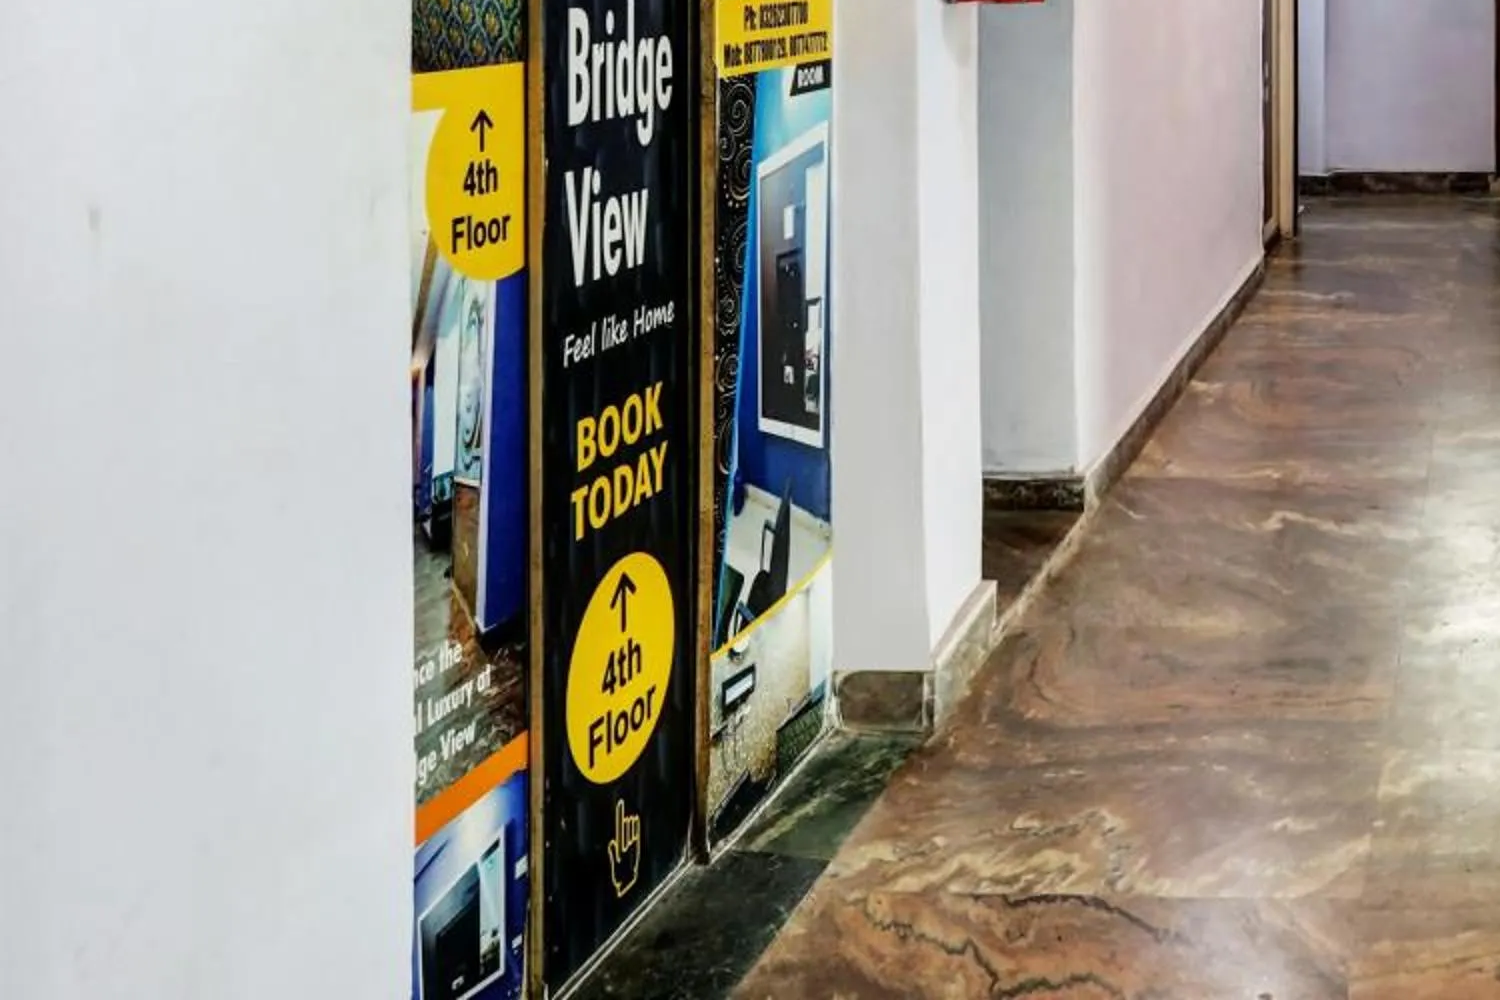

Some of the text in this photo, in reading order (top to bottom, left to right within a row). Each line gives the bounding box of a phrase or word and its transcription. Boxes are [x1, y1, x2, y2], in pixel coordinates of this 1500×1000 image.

[463, 159, 498, 196] 4th
[451, 214, 511, 254] Floor
[565, 166, 648, 288] View
[563, 301, 675, 368] Feel like Home
[577, 381, 663, 472] BOOK
[571, 440, 668, 541] TODAY
[602, 637, 641, 695] 4th
[427, 680, 474, 727] Luxury
[588, 684, 656, 769] Floor
[440, 719, 476, 760] View
